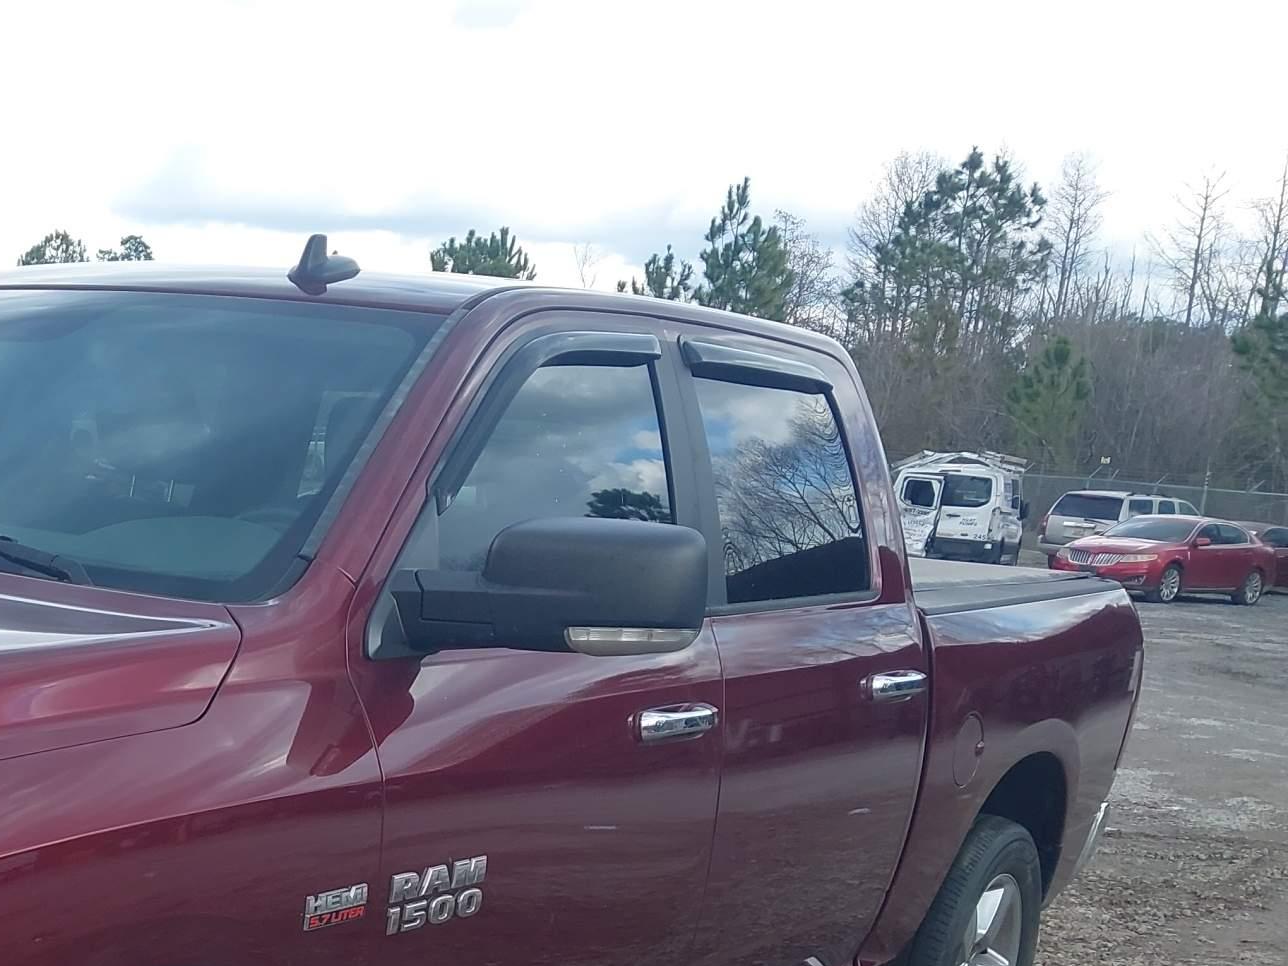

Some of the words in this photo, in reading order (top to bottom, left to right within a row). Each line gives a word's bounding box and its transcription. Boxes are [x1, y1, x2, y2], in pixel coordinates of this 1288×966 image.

[305, 882, 369, 916] HEMI
[389, 855, 488, 904] RAM
[309, 913, 331, 929] 5.7
[330, 905, 365, 922] LITER
[385, 887, 483, 936] 1500
